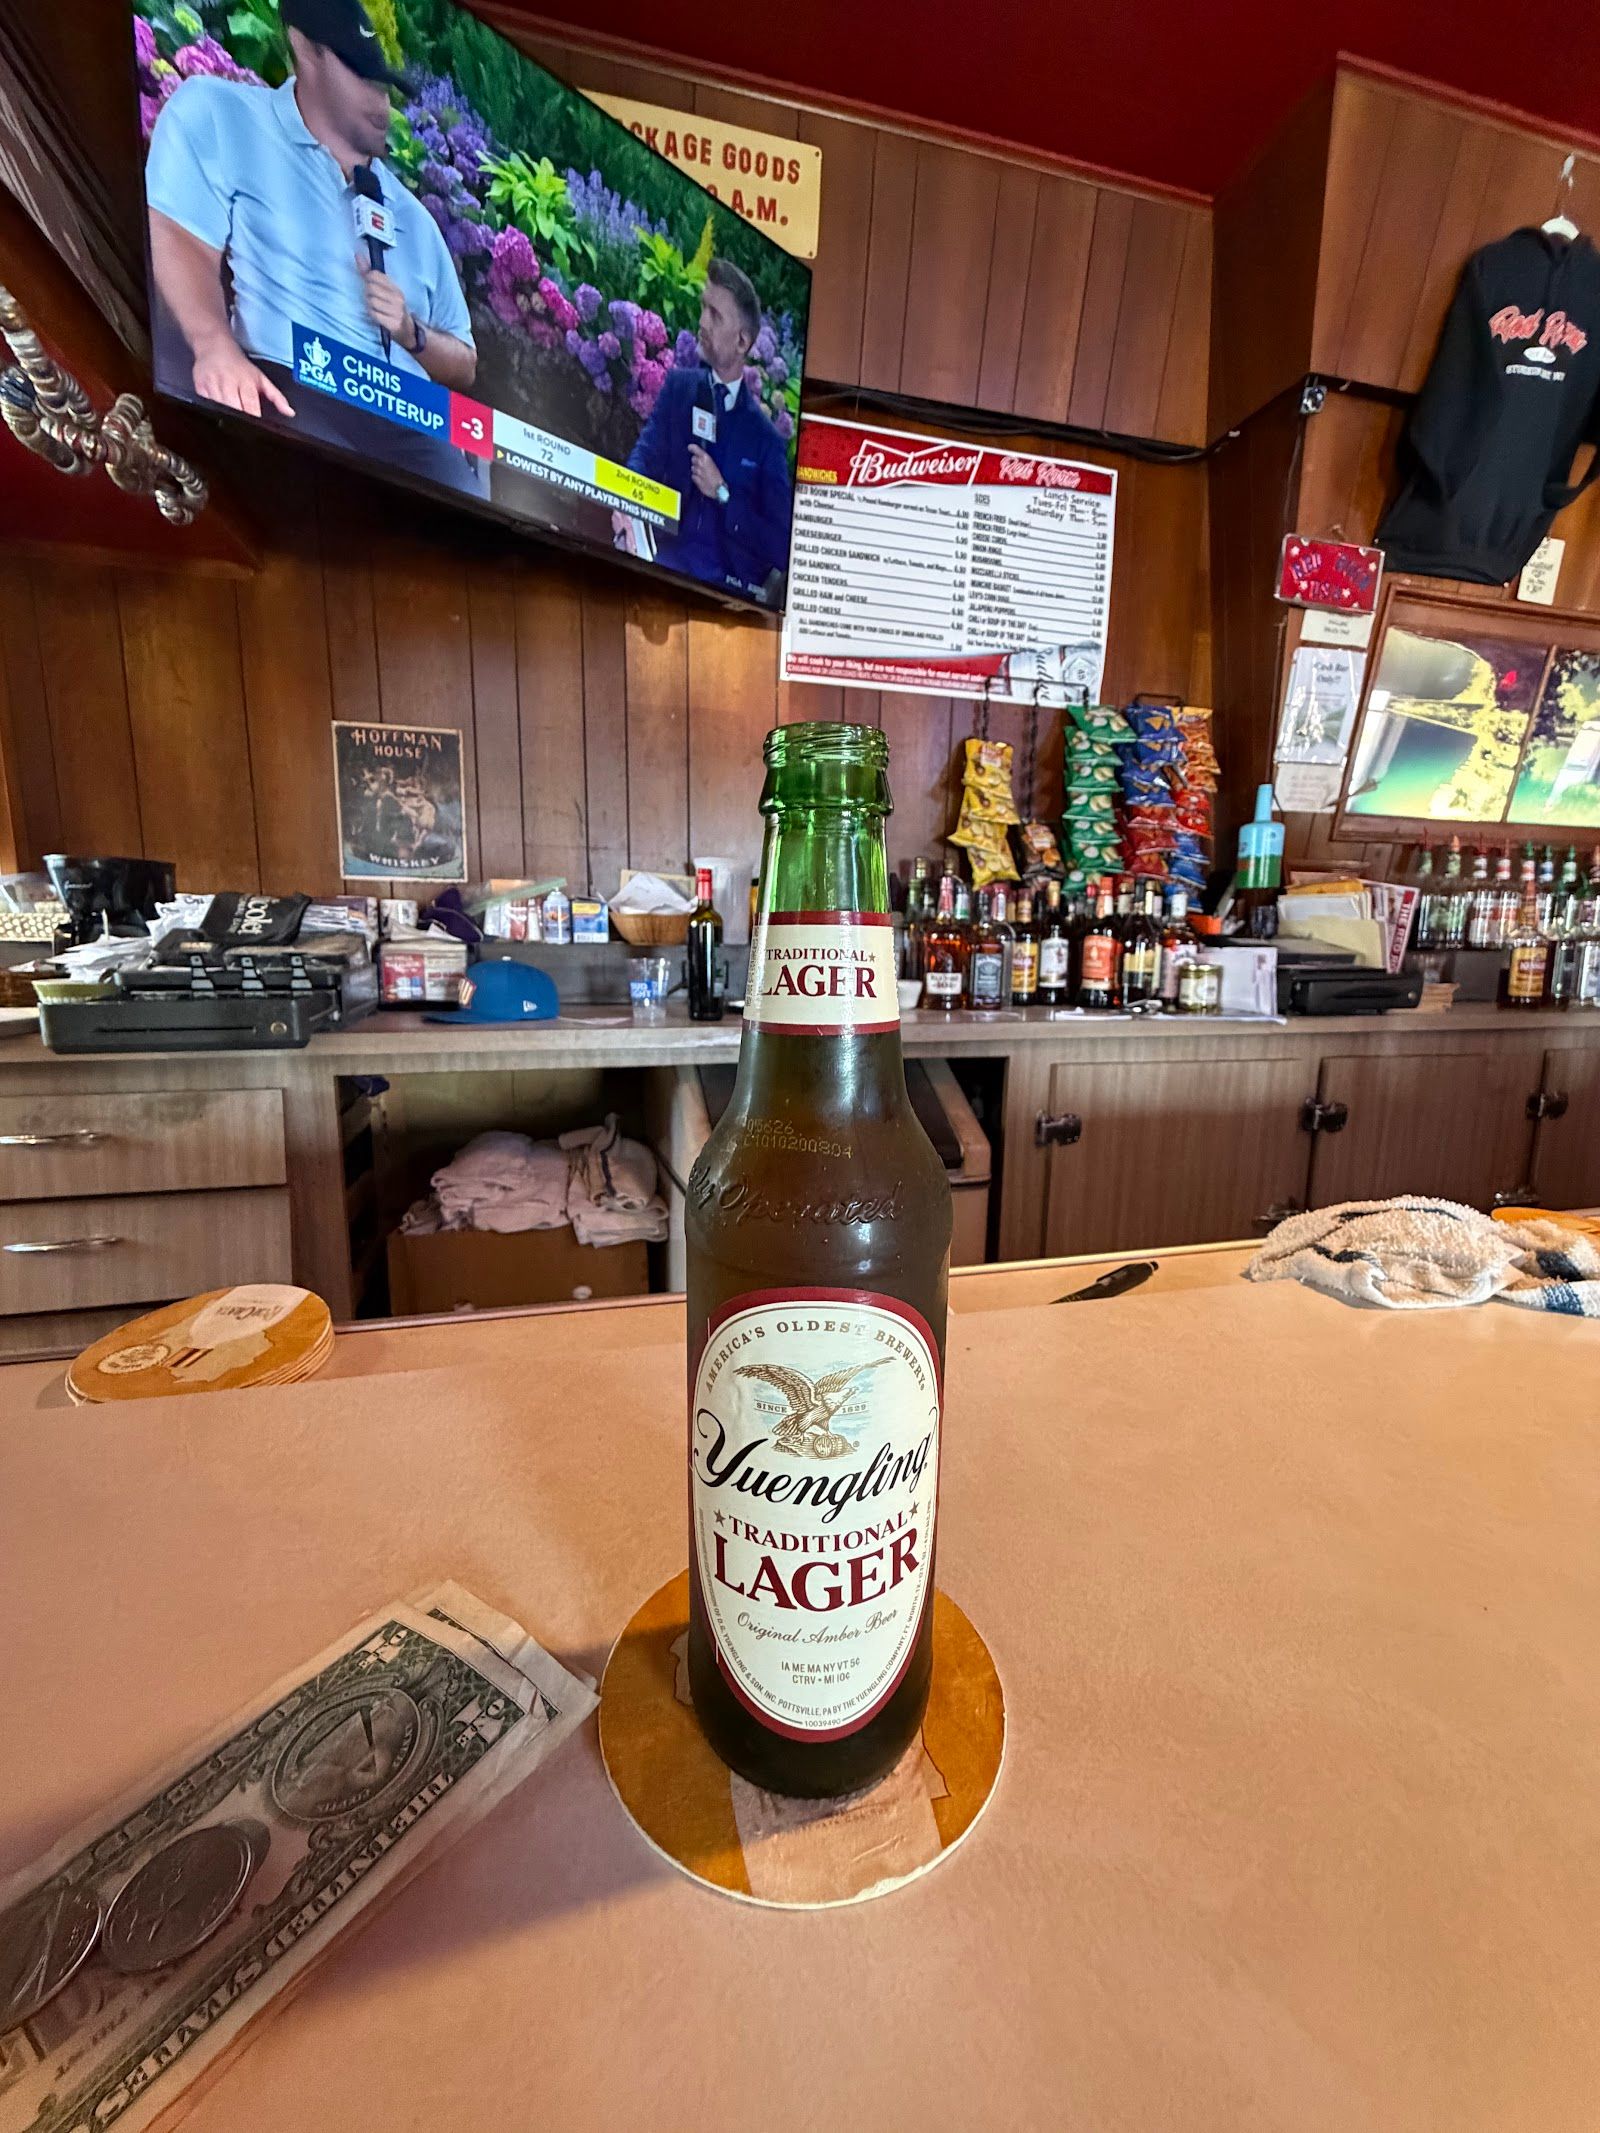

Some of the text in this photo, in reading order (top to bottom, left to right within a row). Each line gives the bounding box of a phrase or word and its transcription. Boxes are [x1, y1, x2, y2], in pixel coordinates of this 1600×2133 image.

[616, 119, 801, 184] CKAGE GOODS
[731, 189, 789, 226] A.M.
[299, 358, 337, 387] PGA
[342, 355, 402, 393] CHRIS
[343, 377, 444, 430] GOTTERUP
[461, 417, 484, 440] -3
[523, 427, 571, 456] 1st ROUND
[541, 449, 553, 463] 72
[850, 451, 979, 484] Budweiser
[999, 456, 1036, 481] Red
[506, 454, 666, 526] LOWEST BY ANY PLAYER THIS WEEK
[616, 469, 661, 495] 2nd ROUND
[632, 487, 644, 501] 65
[1026, 504, 1064, 522] Saturday
[1044, 489, 1101, 508] Lunch Service
[351, 729, 442, 751] HOFFMAN
[375, 745, 422, 759] HOUSE
[369, 853, 440, 868] WHISKEY
[767, 948, 867, 962] TRADITIONAL
[705, 1320, 867, 1393] AMERICA'S OLDEST
[756, 1402, 788, 1414] SINCE
[729, 1510, 908, 1553] TRADITIONAL
[713, 1528, 920, 1612] LAGER
[737, 1609, 897, 1644] Original Amber Beer
[723, 1633, 748, 1674] YUENGLING
[745, 1672, 752, 1680] &
[823, 1706, 832, 1716] PA
[833, 1703, 842, 1714] BY
[843, 1698, 856, 1711] THE
[855, 1668, 888, 1702] YUENGLING
[781, 1661, 790, 1672] IA
[792, 1662, 805, 1673] ME
[807, 1664, 820, 1673] MA
[823, 1663, 835, 1673] NY
[836, 1660, 849, 1672] VT
[792, 1675, 816, 1685] CTRV
[824, 1675, 834, 1685] MI
[455, 1698, 505, 1749] ONE
[805, 1719, 841, 1727] 10039490
[391, 1771, 454, 1832] THE
[265, 1832, 391, 1959] UNITED
[95, 1955, 265, 2119] STATES
